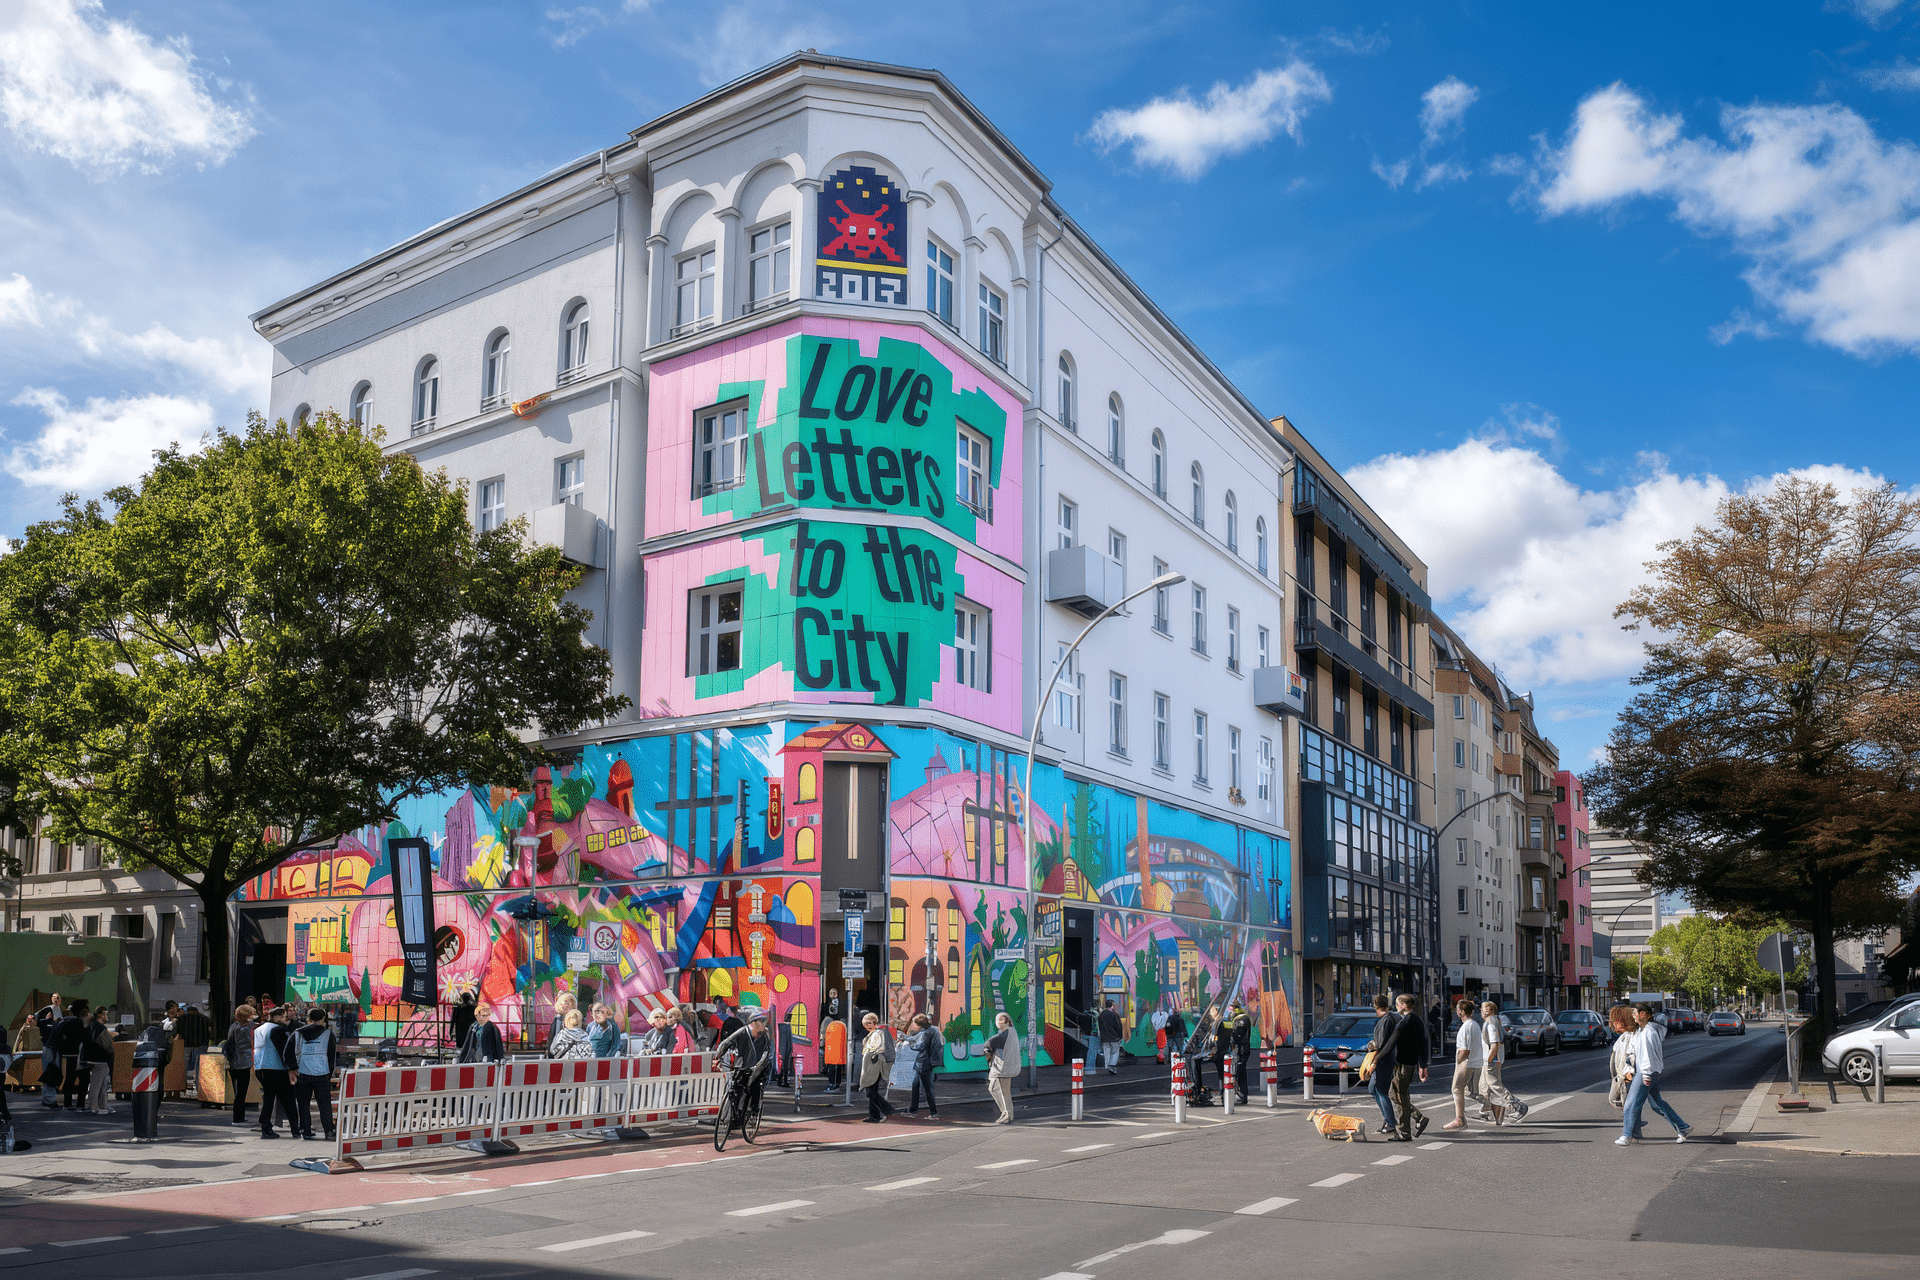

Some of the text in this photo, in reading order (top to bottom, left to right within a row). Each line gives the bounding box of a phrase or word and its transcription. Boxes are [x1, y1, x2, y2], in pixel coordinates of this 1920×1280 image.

[798, 343, 933, 427] Love
[754, 427, 945, 519] Letters
[789, 523, 944, 612] to the
[794, 607, 909, 707] City
